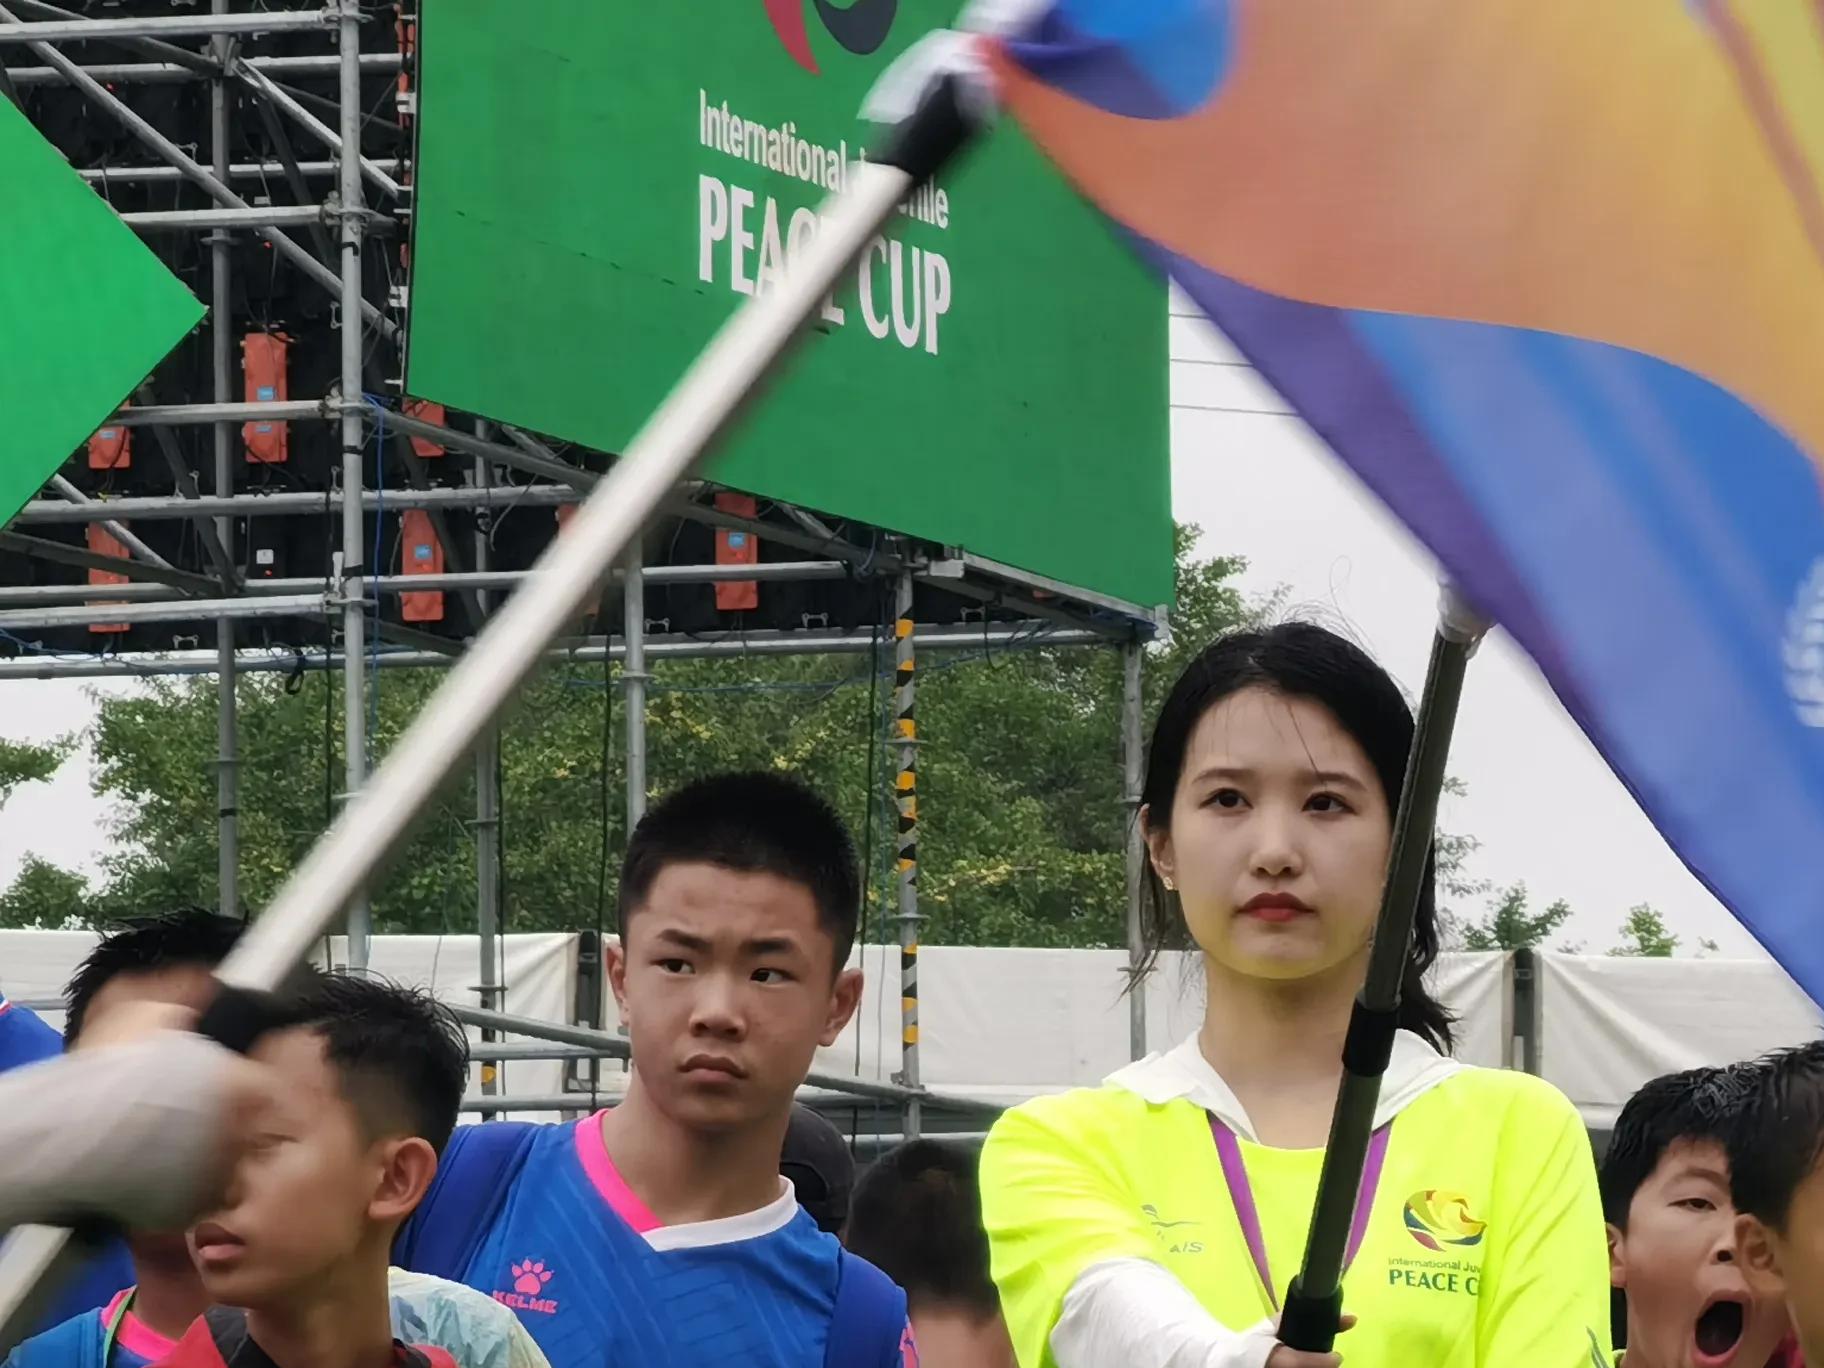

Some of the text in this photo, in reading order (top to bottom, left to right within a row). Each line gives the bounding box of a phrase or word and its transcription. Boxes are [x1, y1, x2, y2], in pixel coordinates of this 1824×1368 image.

[700, 88, 847, 195] International
[858, 234, 951, 356] CUP
[1389, 1269, 1459, 1293] PEACE
